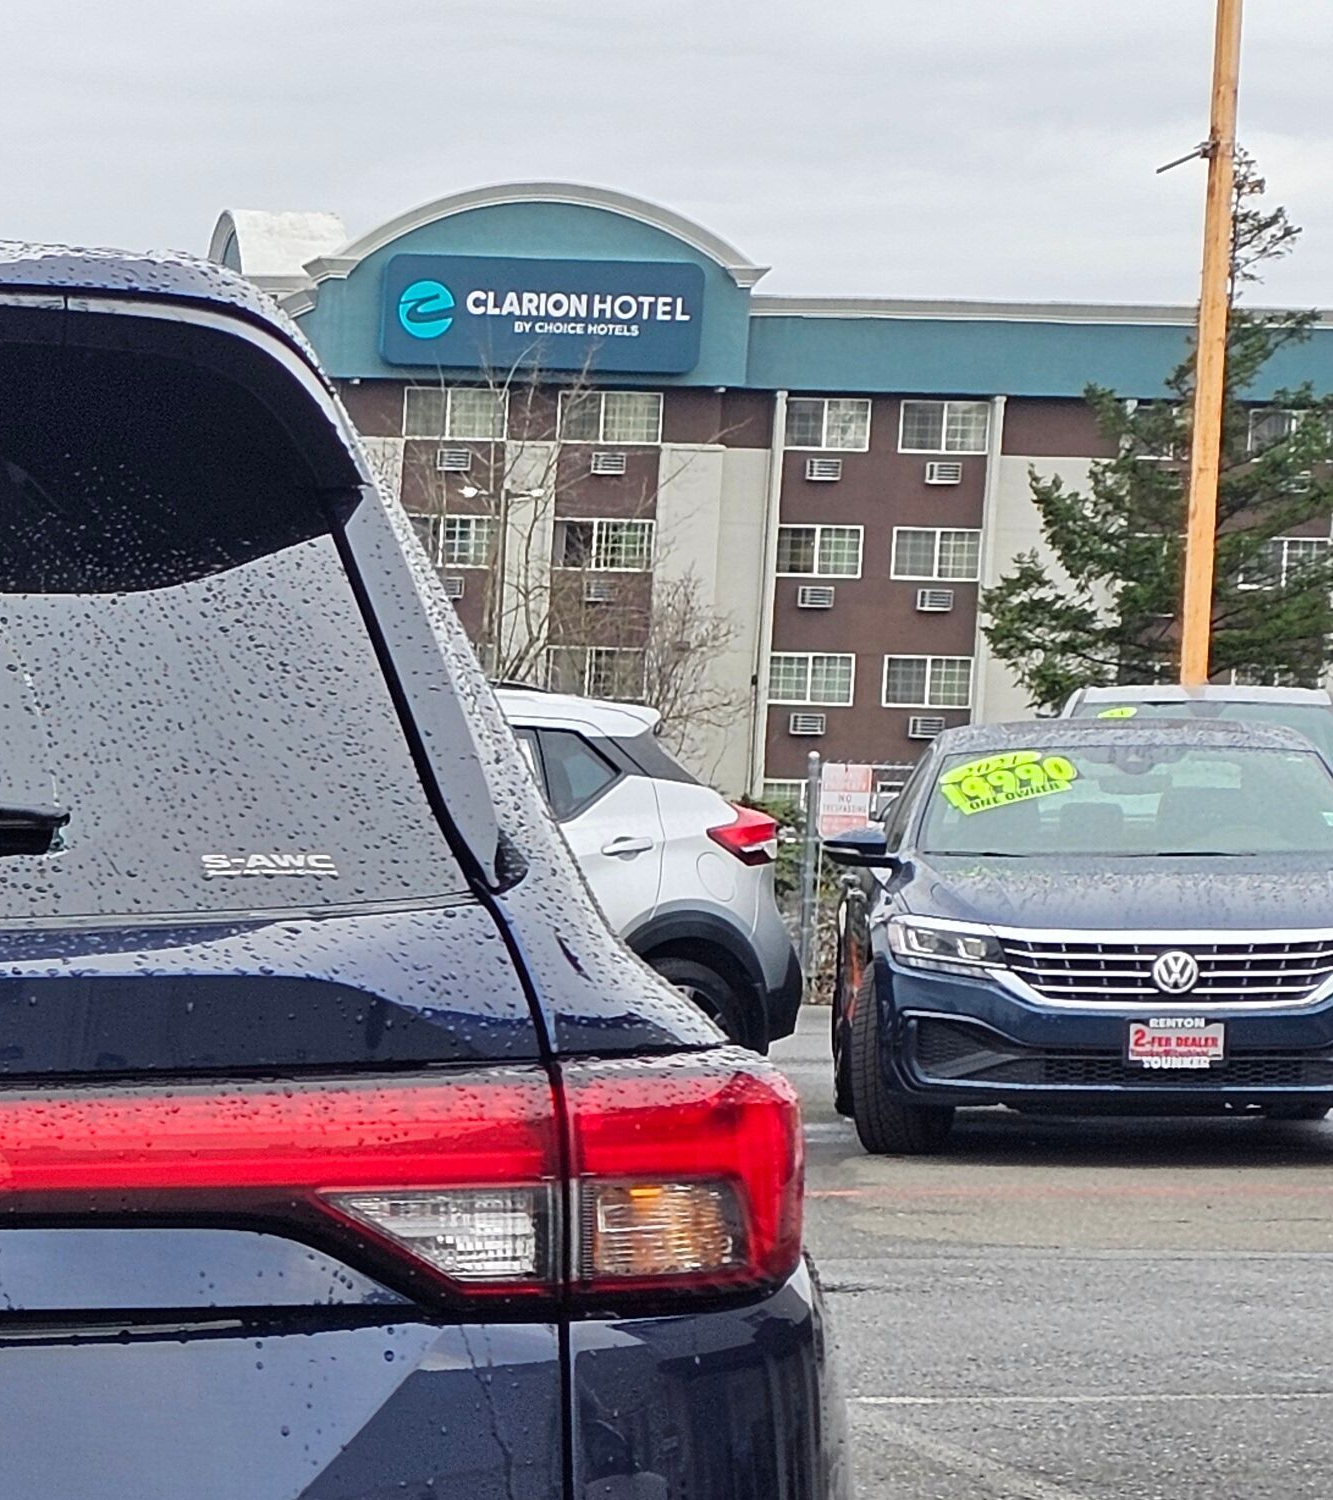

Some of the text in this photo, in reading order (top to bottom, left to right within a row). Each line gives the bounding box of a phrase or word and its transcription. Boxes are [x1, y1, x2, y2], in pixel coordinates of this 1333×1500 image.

[466, 290, 691, 321] CLARION HOTEL
[514, 321, 639, 337] BY CHOICE HOTELS
[941, 756, 1078, 808] 19990
[838, 794, 851, 804] NO
[201, 854, 335, 868] S-AWC
[1149, 1017, 1205, 1028] RENTON
[1134, 1029, 1218, 1048] 2-FER DEALER
[1142, 1056, 1210, 1069] YOUNKER
